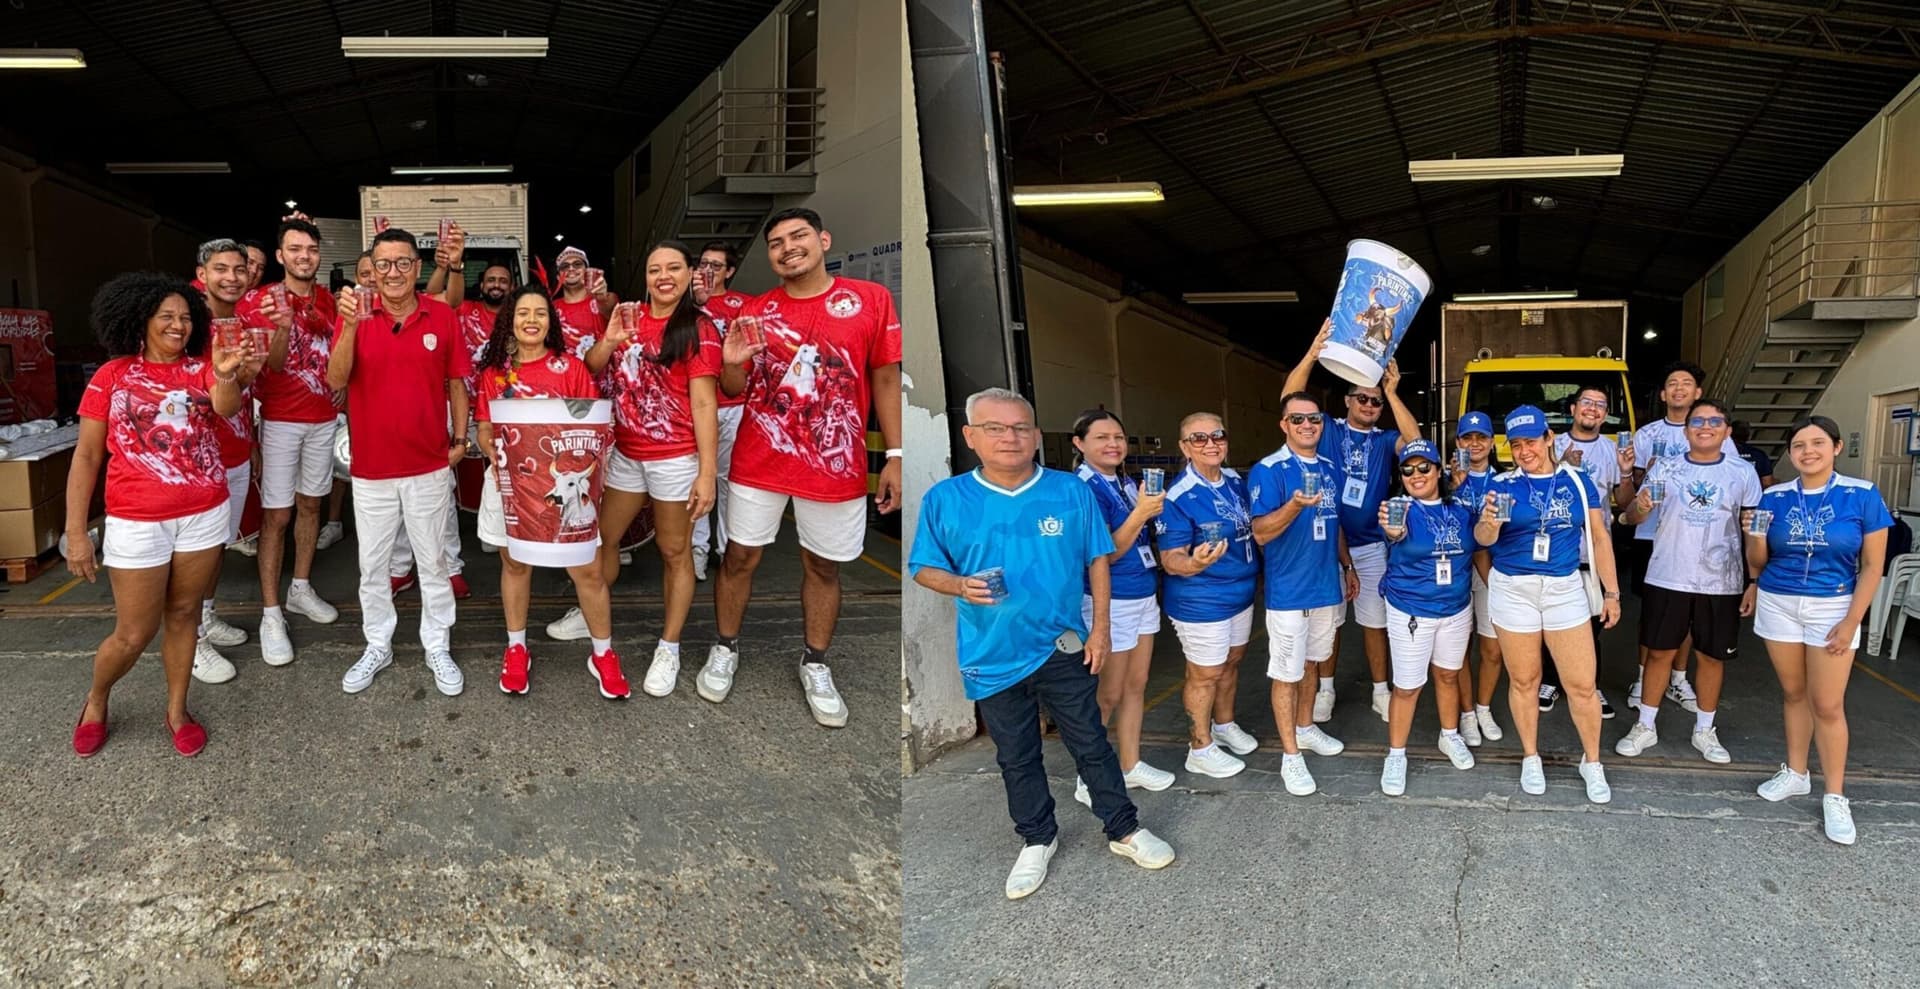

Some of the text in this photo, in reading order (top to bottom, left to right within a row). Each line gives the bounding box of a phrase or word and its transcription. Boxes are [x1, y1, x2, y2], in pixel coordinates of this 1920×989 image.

[1378, 275, 1413, 304] PARINTINS
[495, 438, 507, 468] 3
[550, 437, 602, 454] PARINTINS
